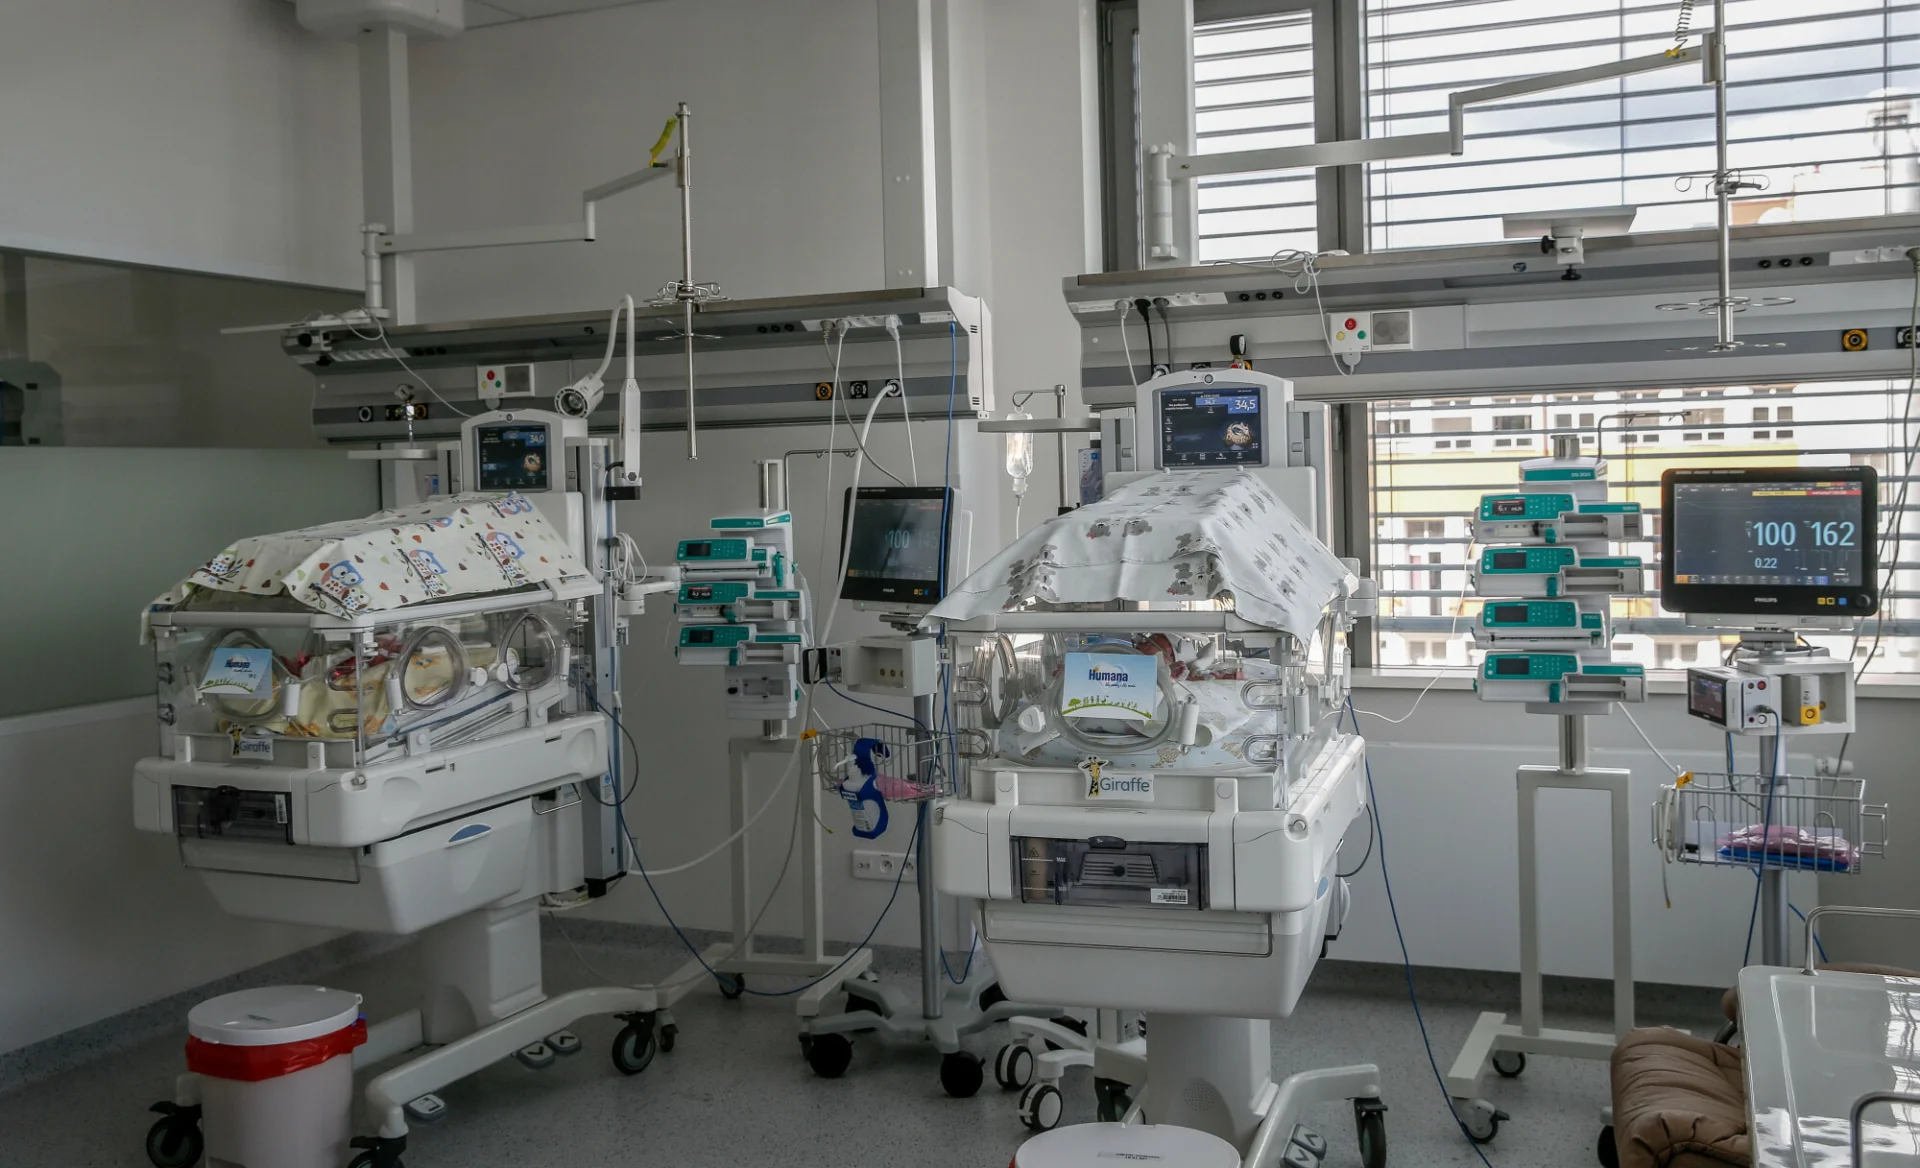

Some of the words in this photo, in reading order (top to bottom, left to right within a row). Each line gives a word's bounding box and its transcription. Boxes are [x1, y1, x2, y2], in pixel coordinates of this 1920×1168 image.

[1235, 399, 1256, 411] 34,5
[888, 529, 910, 549] 100
[1753, 521, 1796, 546] 100
[1810, 521, 1855, 546] 162
[1754, 557, 1778, 569] 0.22
[1089, 669, 1128, 682] Humana
[240, 740, 270, 753] Giraffe
[1100, 777, 1150, 792] Giraffe
